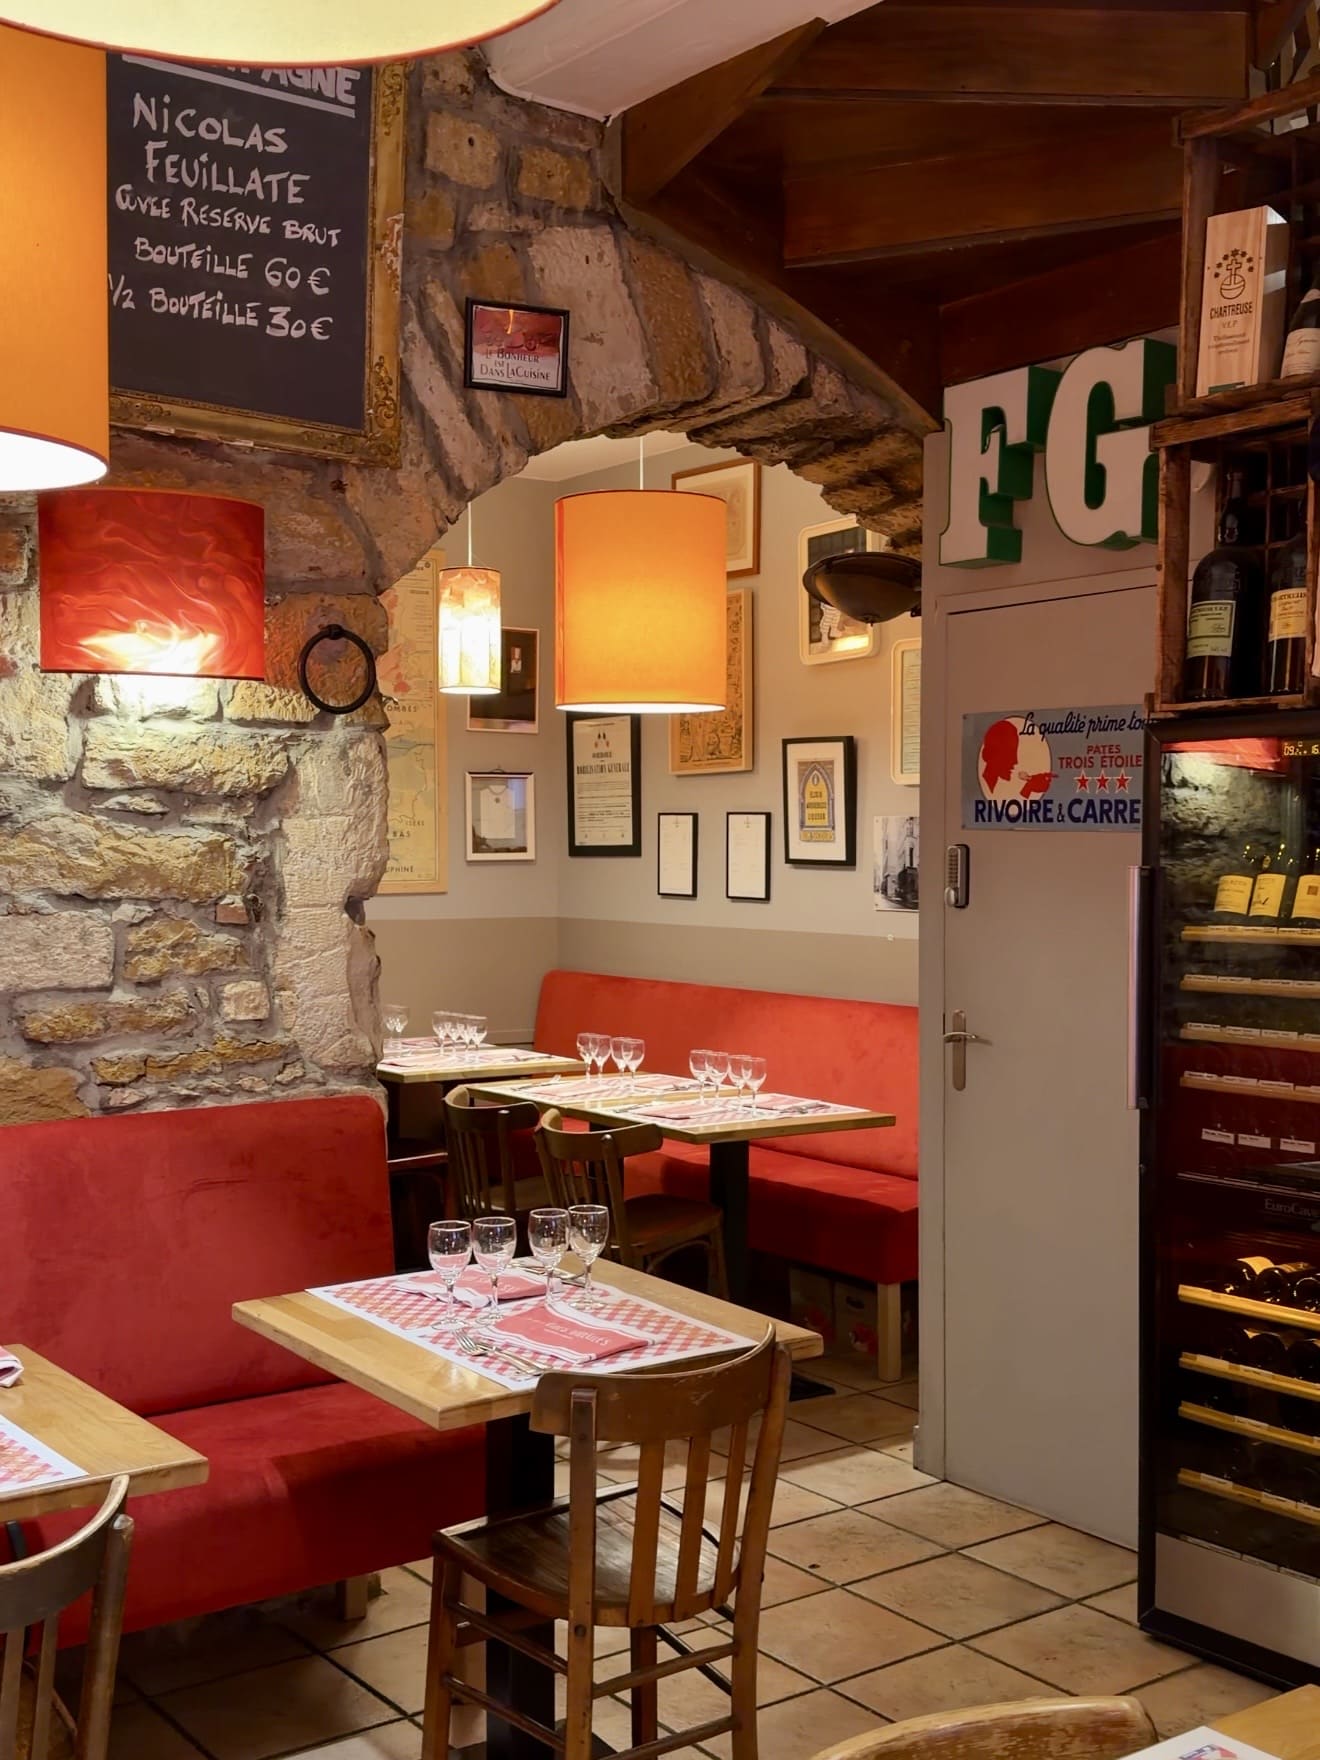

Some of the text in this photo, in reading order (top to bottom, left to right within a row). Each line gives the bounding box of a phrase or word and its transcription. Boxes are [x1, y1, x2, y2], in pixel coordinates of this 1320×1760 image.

[282, 220, 342, 248] BRUT
[1209, 301, 1253, 320] CHARTREUSE
[939, 336, 1160, 568] FG
[1019, 711, 1035, 736] La
[1039, 711, 1086, 742] qualité
[1085, 715, 1125, 739] prime
[1058, 756, 1094, 769] TROIS
[1086, 745, 1121, 755] PATES
[974, 799, 1054, 823] RIVOIRE
[1067, 798, 1141, 824] CARRE
